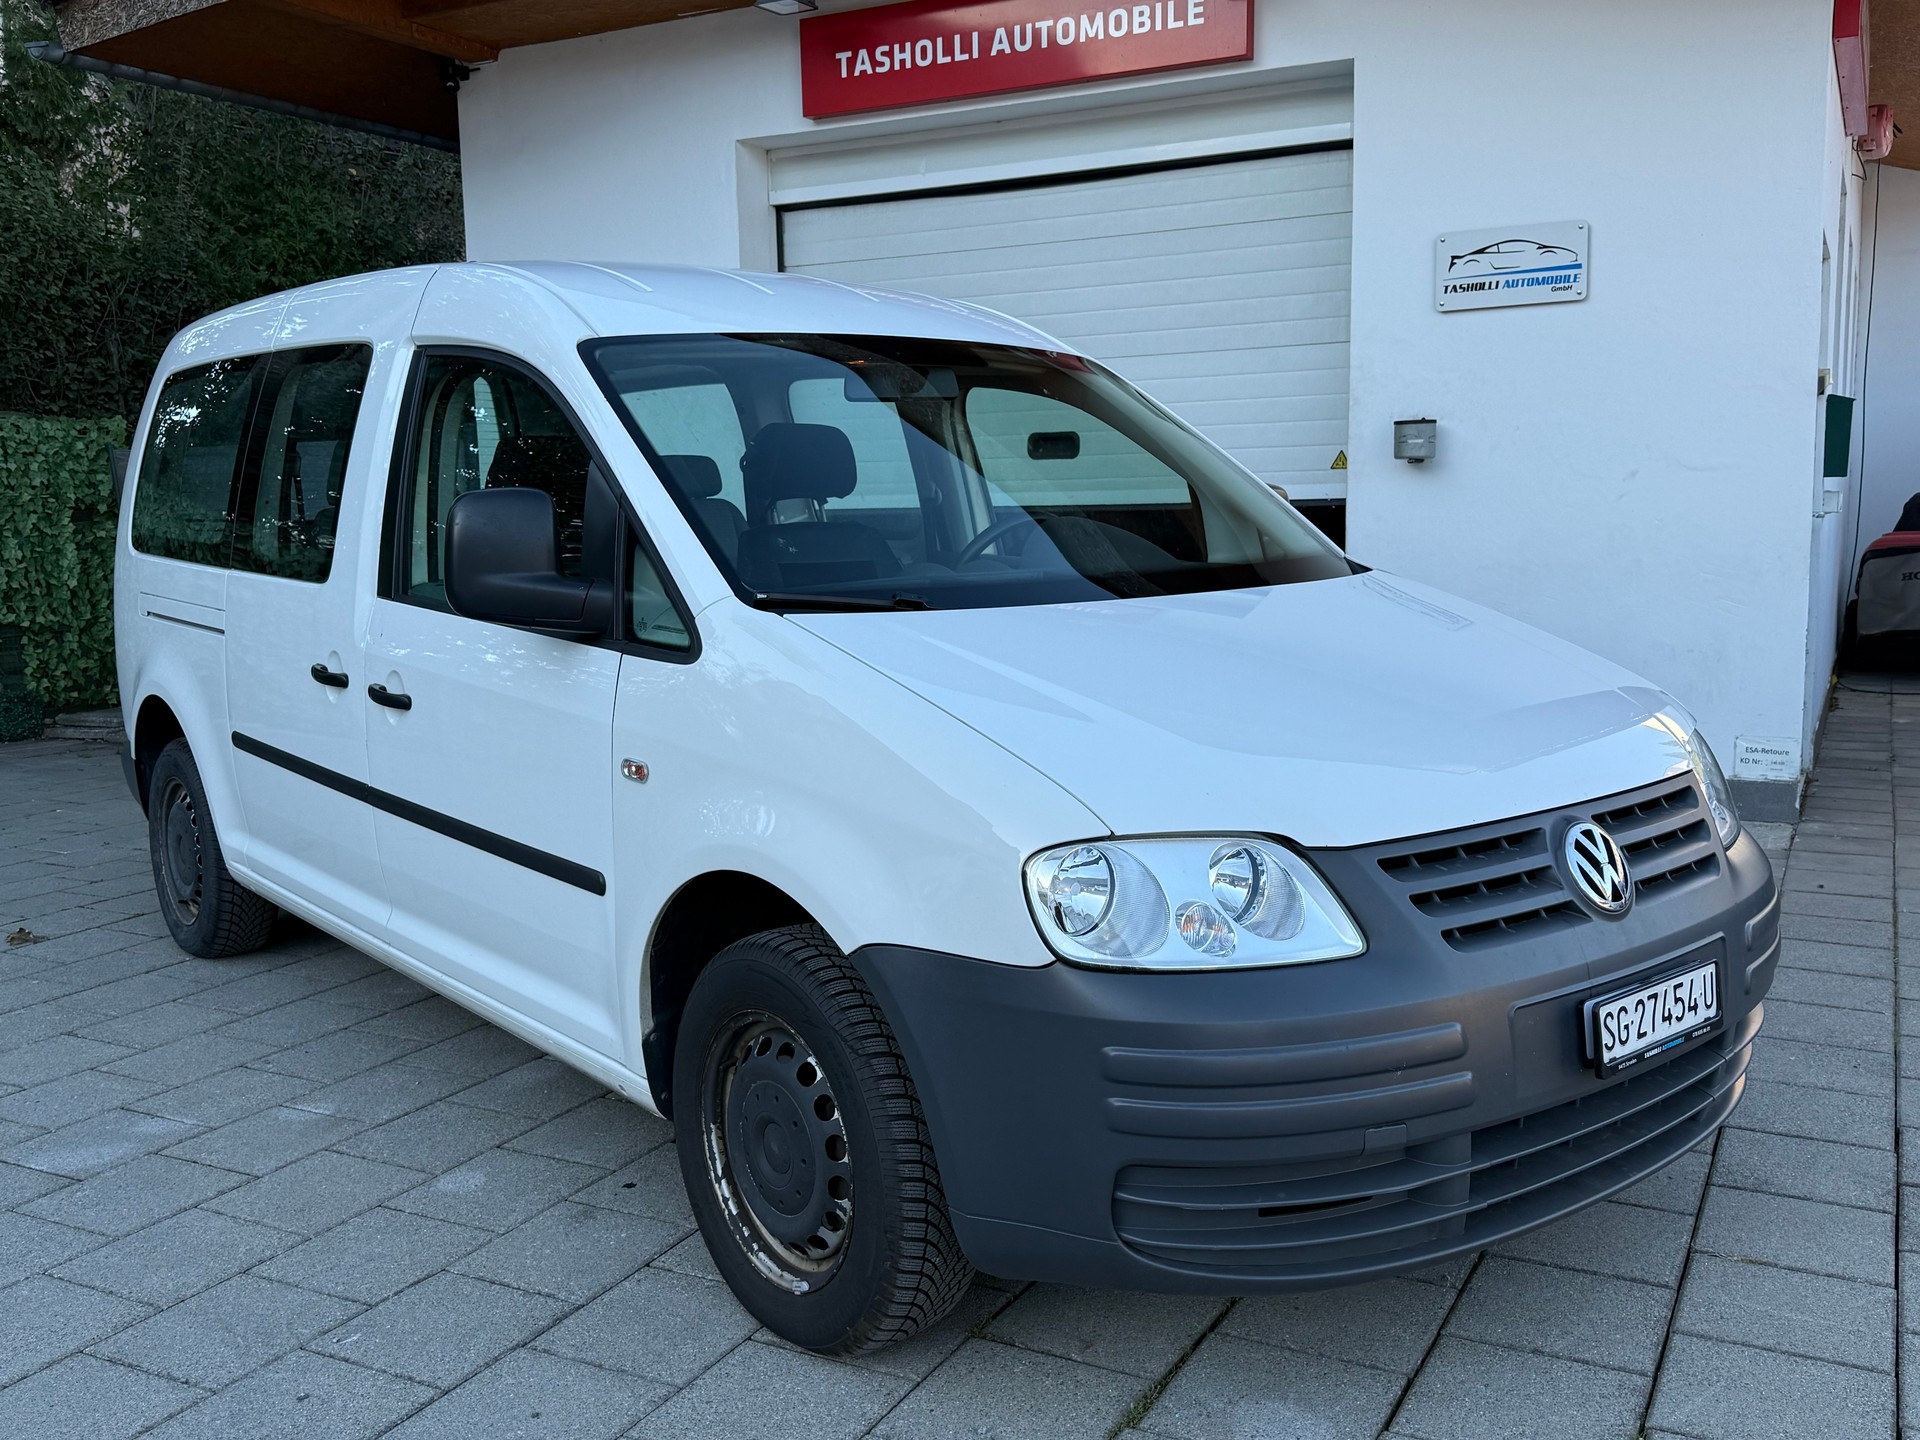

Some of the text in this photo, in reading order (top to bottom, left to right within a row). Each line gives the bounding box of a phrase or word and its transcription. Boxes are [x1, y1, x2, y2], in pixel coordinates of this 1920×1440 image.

[835, 0, 1205, 79] TASHOLLI AUTOMOBILE
[1443, 273, 1581, 294] TASHOLLI AUTOMOBILE
[1550, 284, 1573, 293] GmbH
[1745, 746, 1790, 756] ESA-Retoure
